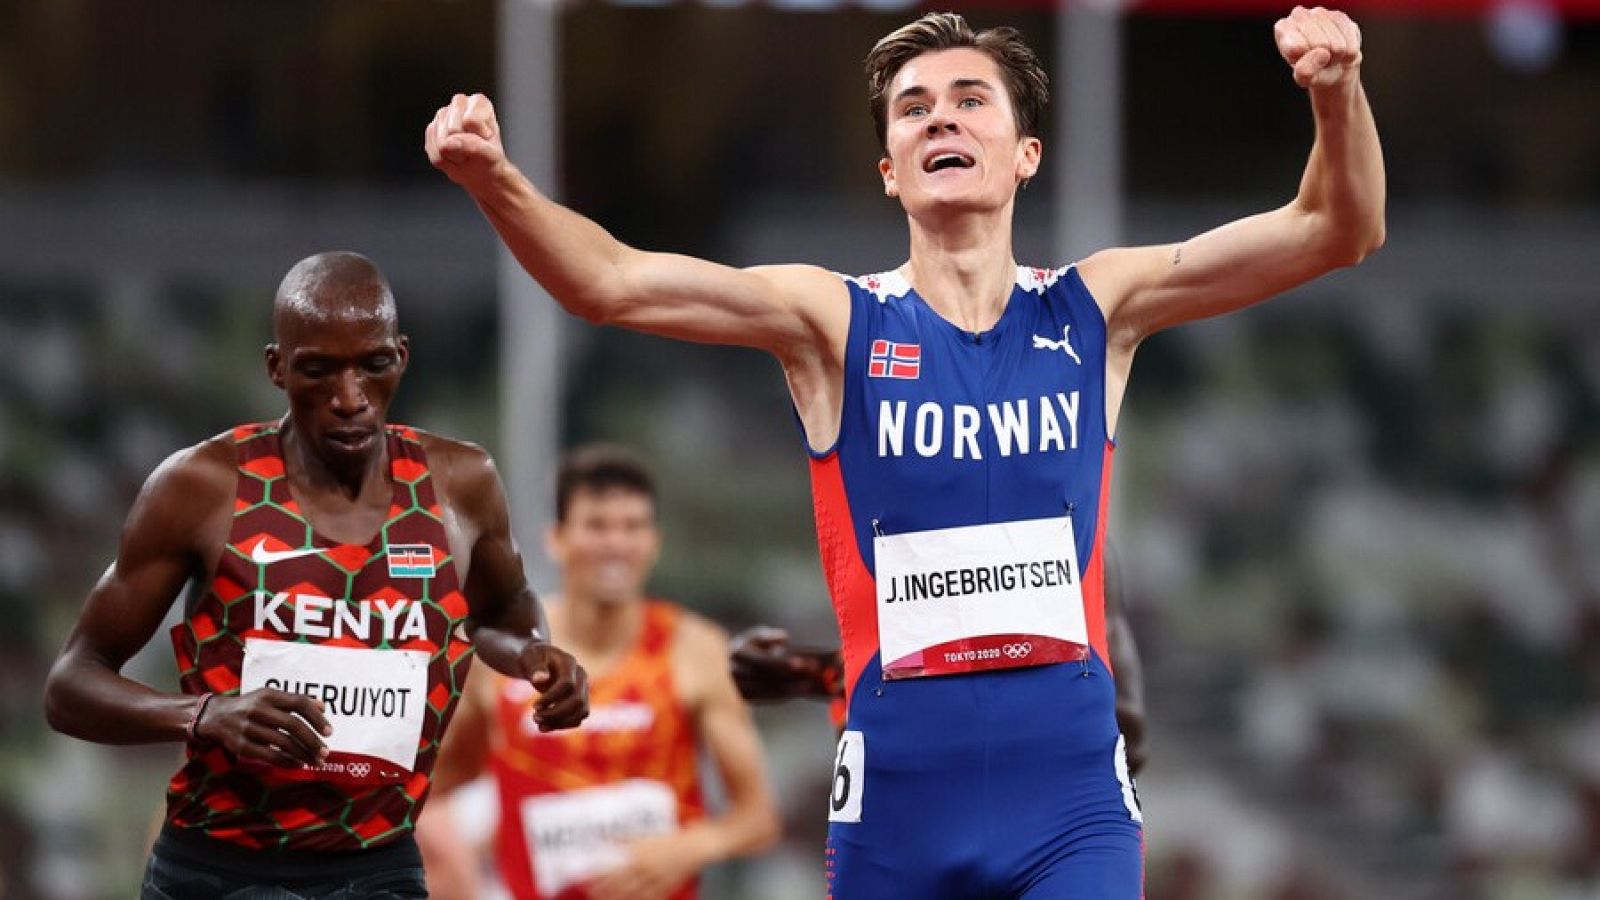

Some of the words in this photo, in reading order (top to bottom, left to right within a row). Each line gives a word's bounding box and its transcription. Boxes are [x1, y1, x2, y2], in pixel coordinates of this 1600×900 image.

[878, 391, 1080, 460] NORWAY
[885, 558, 1073, 604] J.INGEBRIGTSEN
[253, 590, 428, 641] KENYA
[944, 650, 975, 663] TOKYO
[977, 648, 1000, 659] 2020
[831, 740, 851, 811] 6
